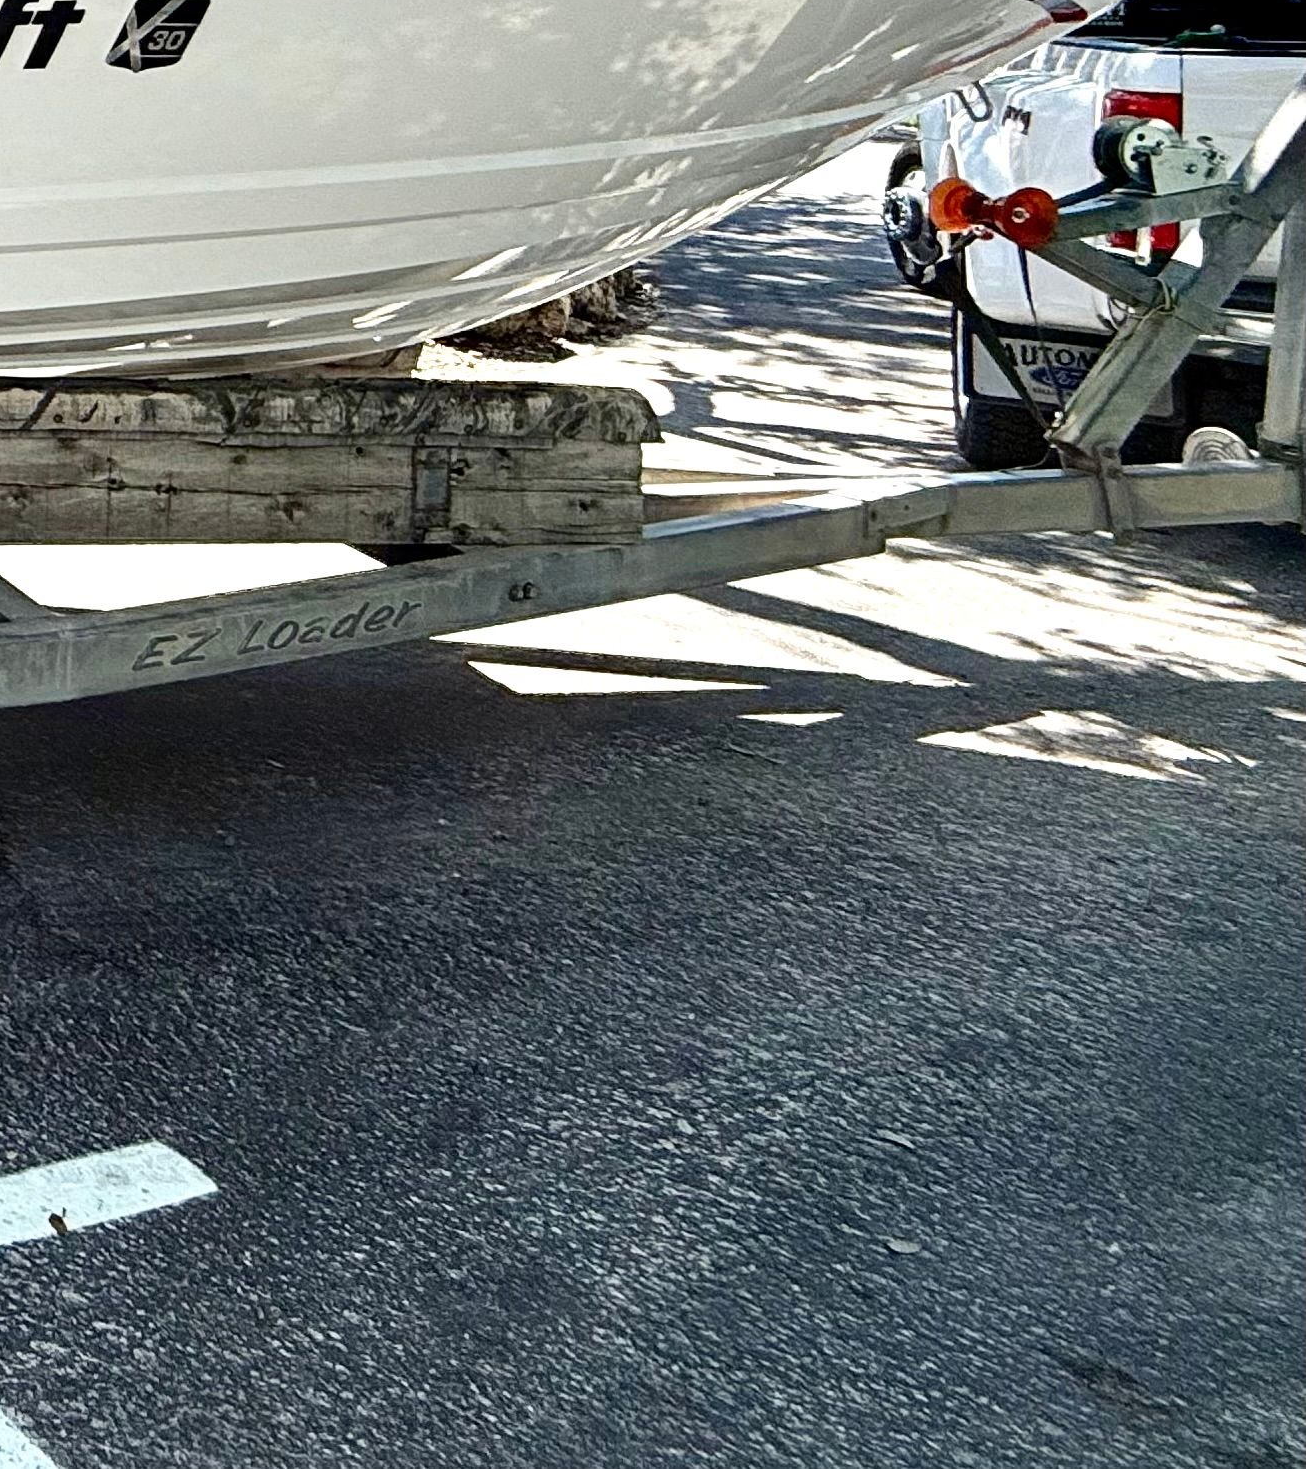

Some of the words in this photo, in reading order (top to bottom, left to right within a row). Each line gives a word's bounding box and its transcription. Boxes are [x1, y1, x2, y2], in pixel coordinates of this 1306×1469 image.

[147, 30, 186, 50] 30
[132, 628, 221, 672] EZ
[238, 600, 422, 656] Loader
